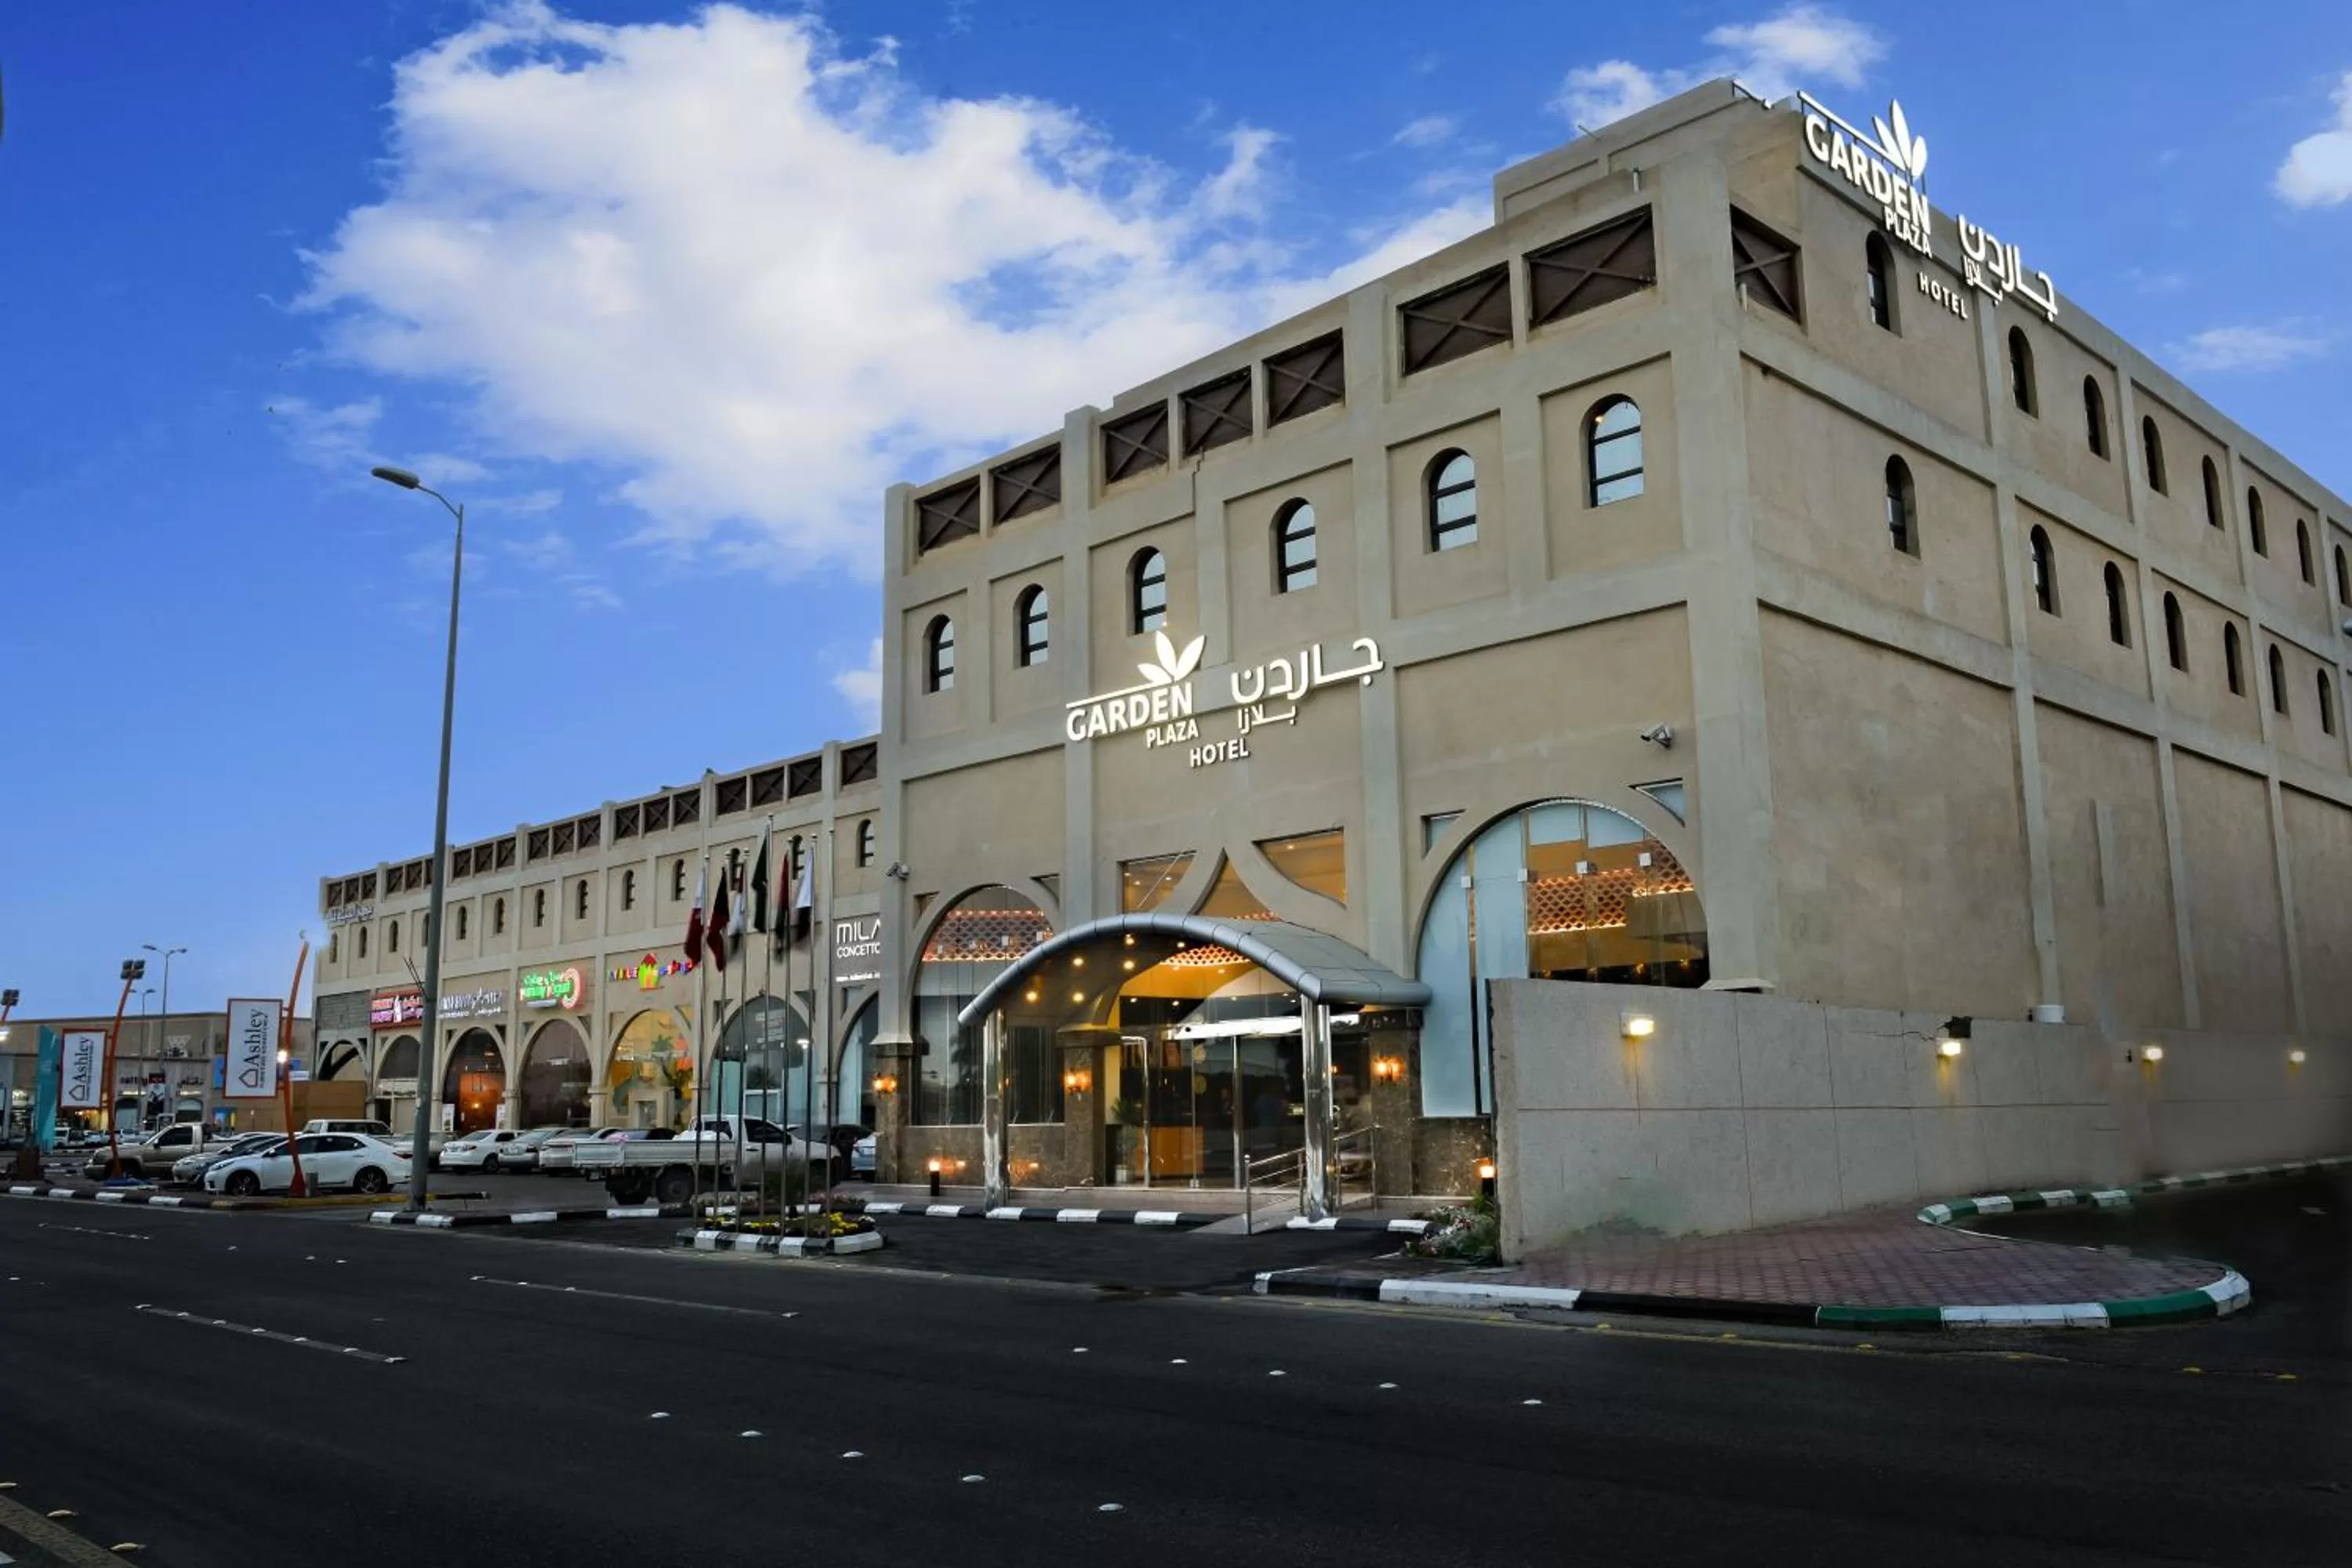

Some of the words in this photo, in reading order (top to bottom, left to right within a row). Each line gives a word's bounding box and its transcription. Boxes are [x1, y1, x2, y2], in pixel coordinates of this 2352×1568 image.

[1806, 114, 1931, 235] GARDEN
[1884, 206, 1933, 258] PLAZA
[1959, 215, 2058, 322] جاردن
[1920, 272, 1969, 319] HOTEL
[1230, 637, 1385, 703] جاردن
[1065, 682, 1193, 741] GARDEN
[1146, 719, 1200, 748] PLAZA
[1237, 704, 1296, 735] بلازا
[1189, 738, 1250, 768] HOTEL
[72, 1036, 94, 1083] Ashley
[243, 1008, 264, 1066] Ashley
